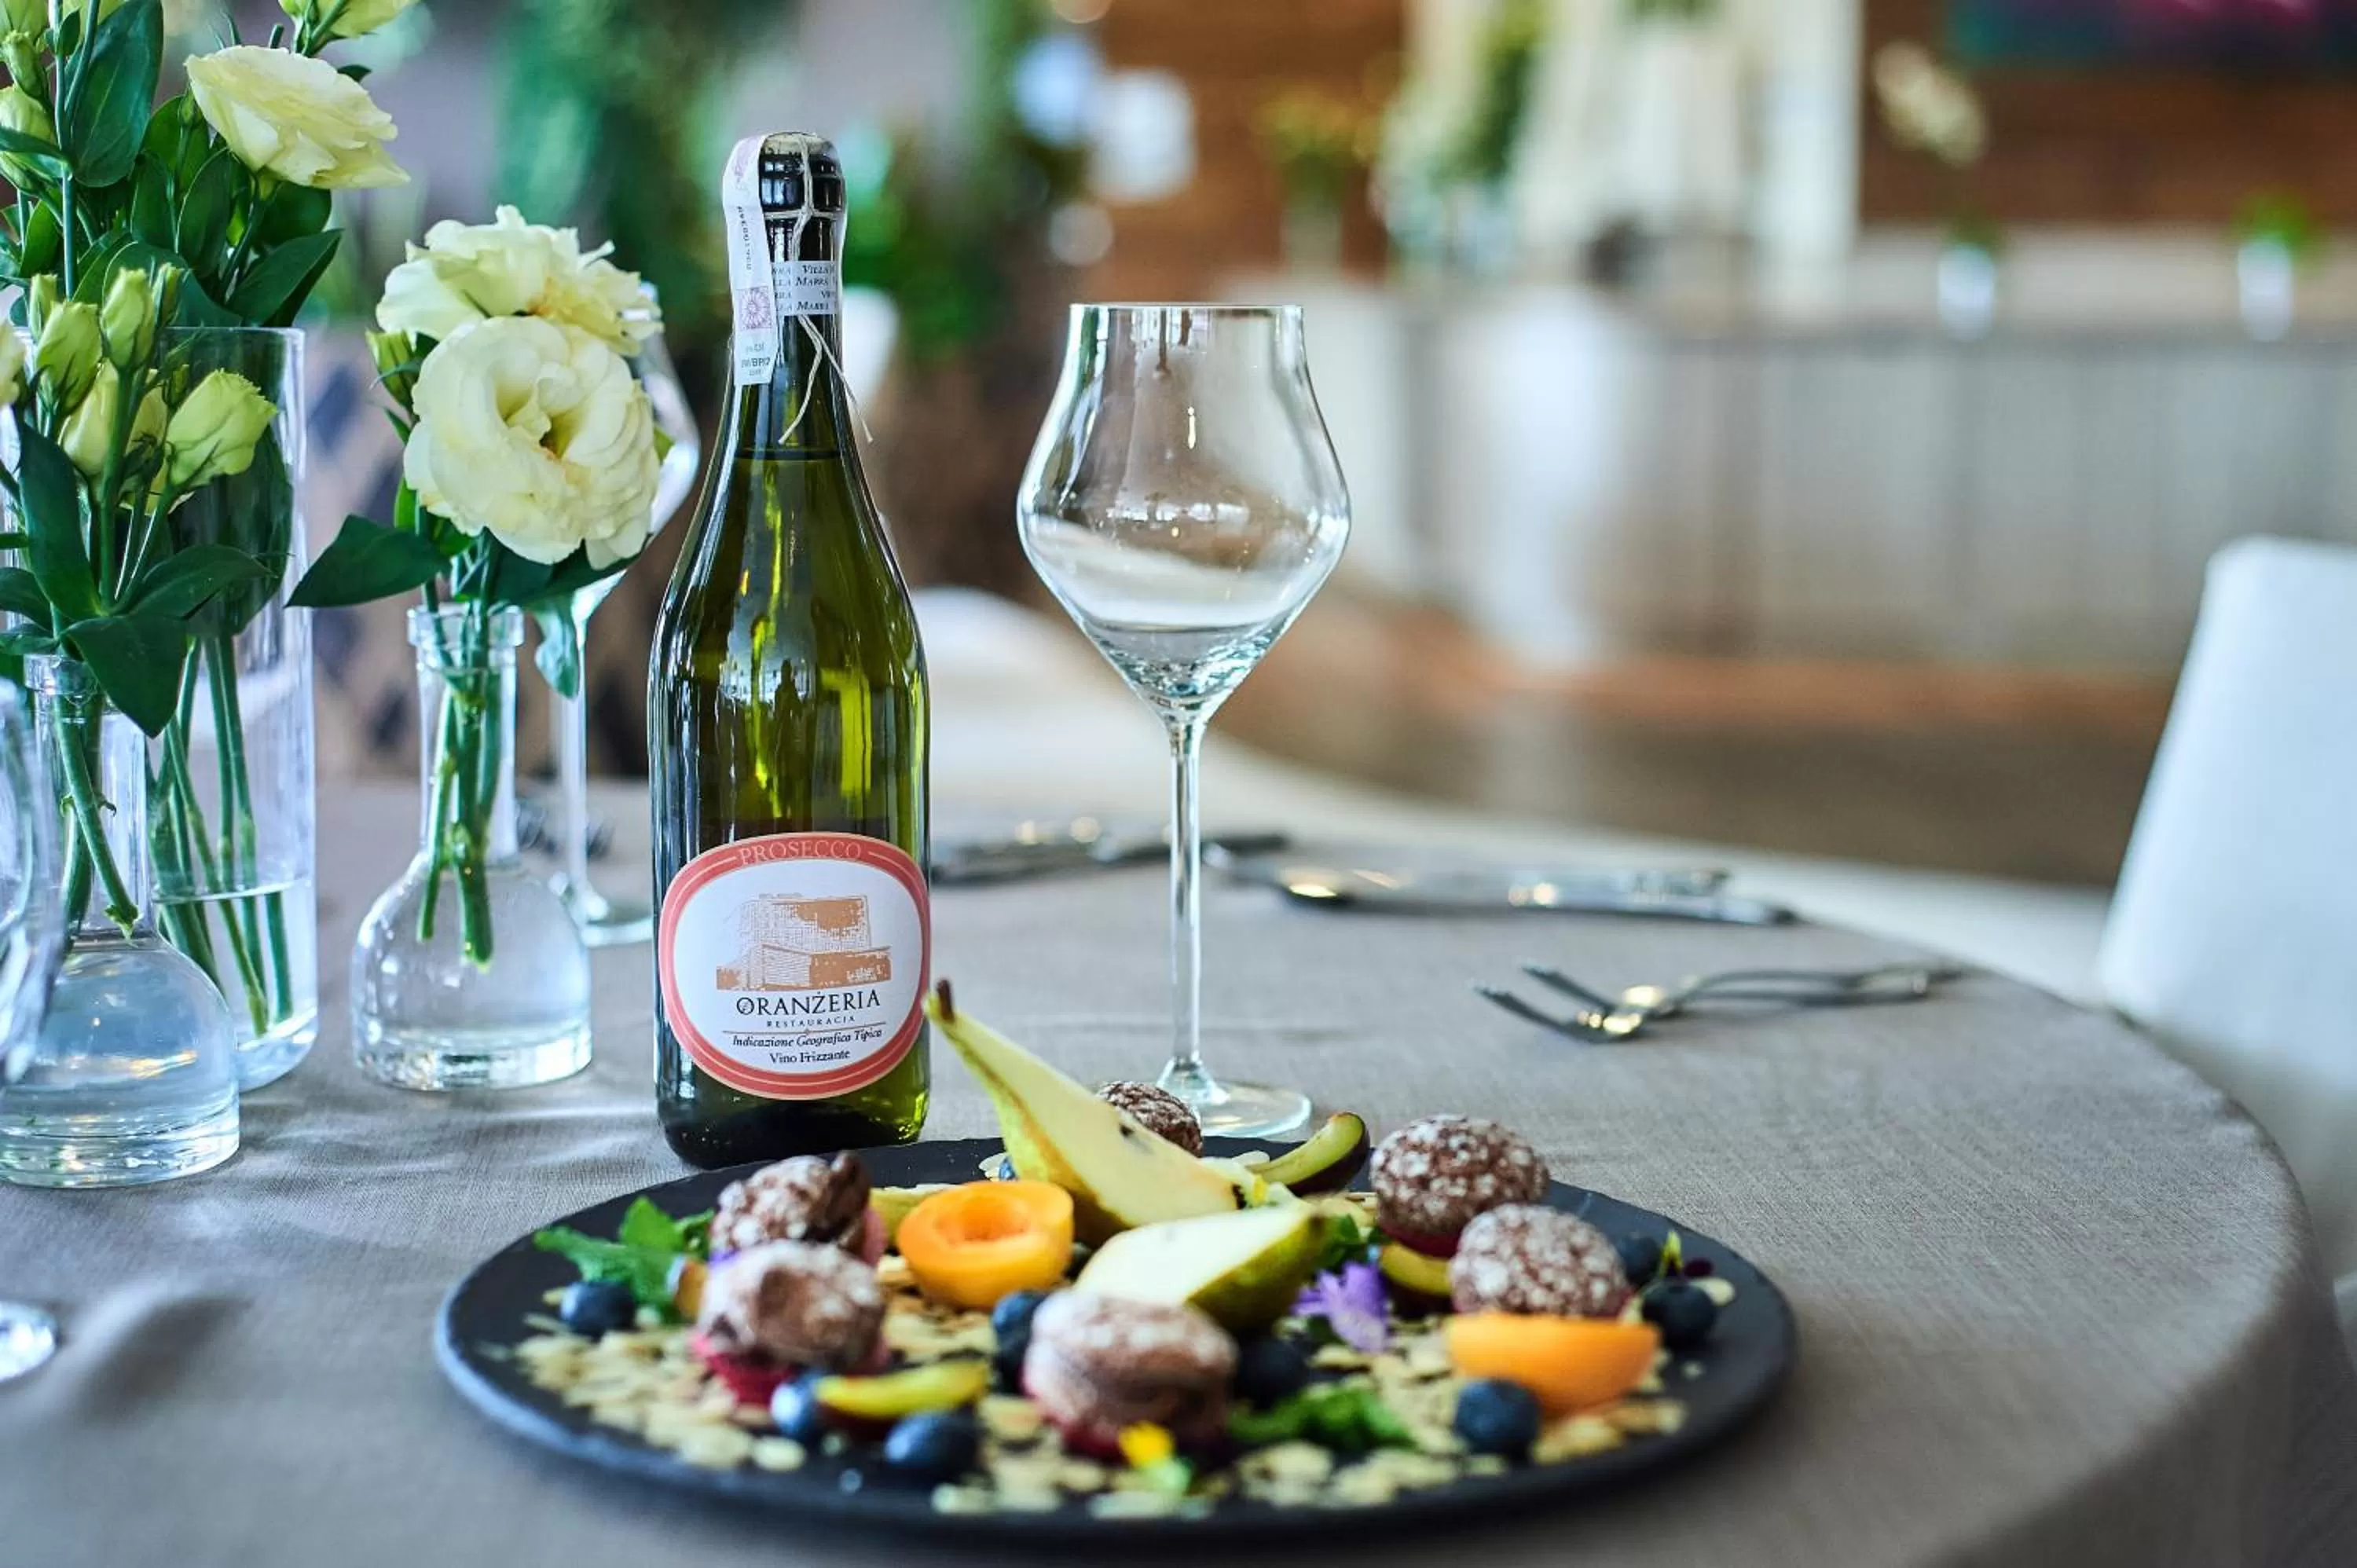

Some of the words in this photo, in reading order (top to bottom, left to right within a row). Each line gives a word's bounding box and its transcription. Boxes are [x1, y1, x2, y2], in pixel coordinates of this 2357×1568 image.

[739, 840, 861, 865] PROSECCO
[736, 989, 880, 1015] ORANŻERIA
[732, 1035, 794, 1048] Indicazione
[796, 1032, 851, 1047] Geografica
[853, 1027, 882, 1042] Tipica
[769, 1052, 797, 1064] Vino
[800, 1049, 851, 1062] Frizzante
